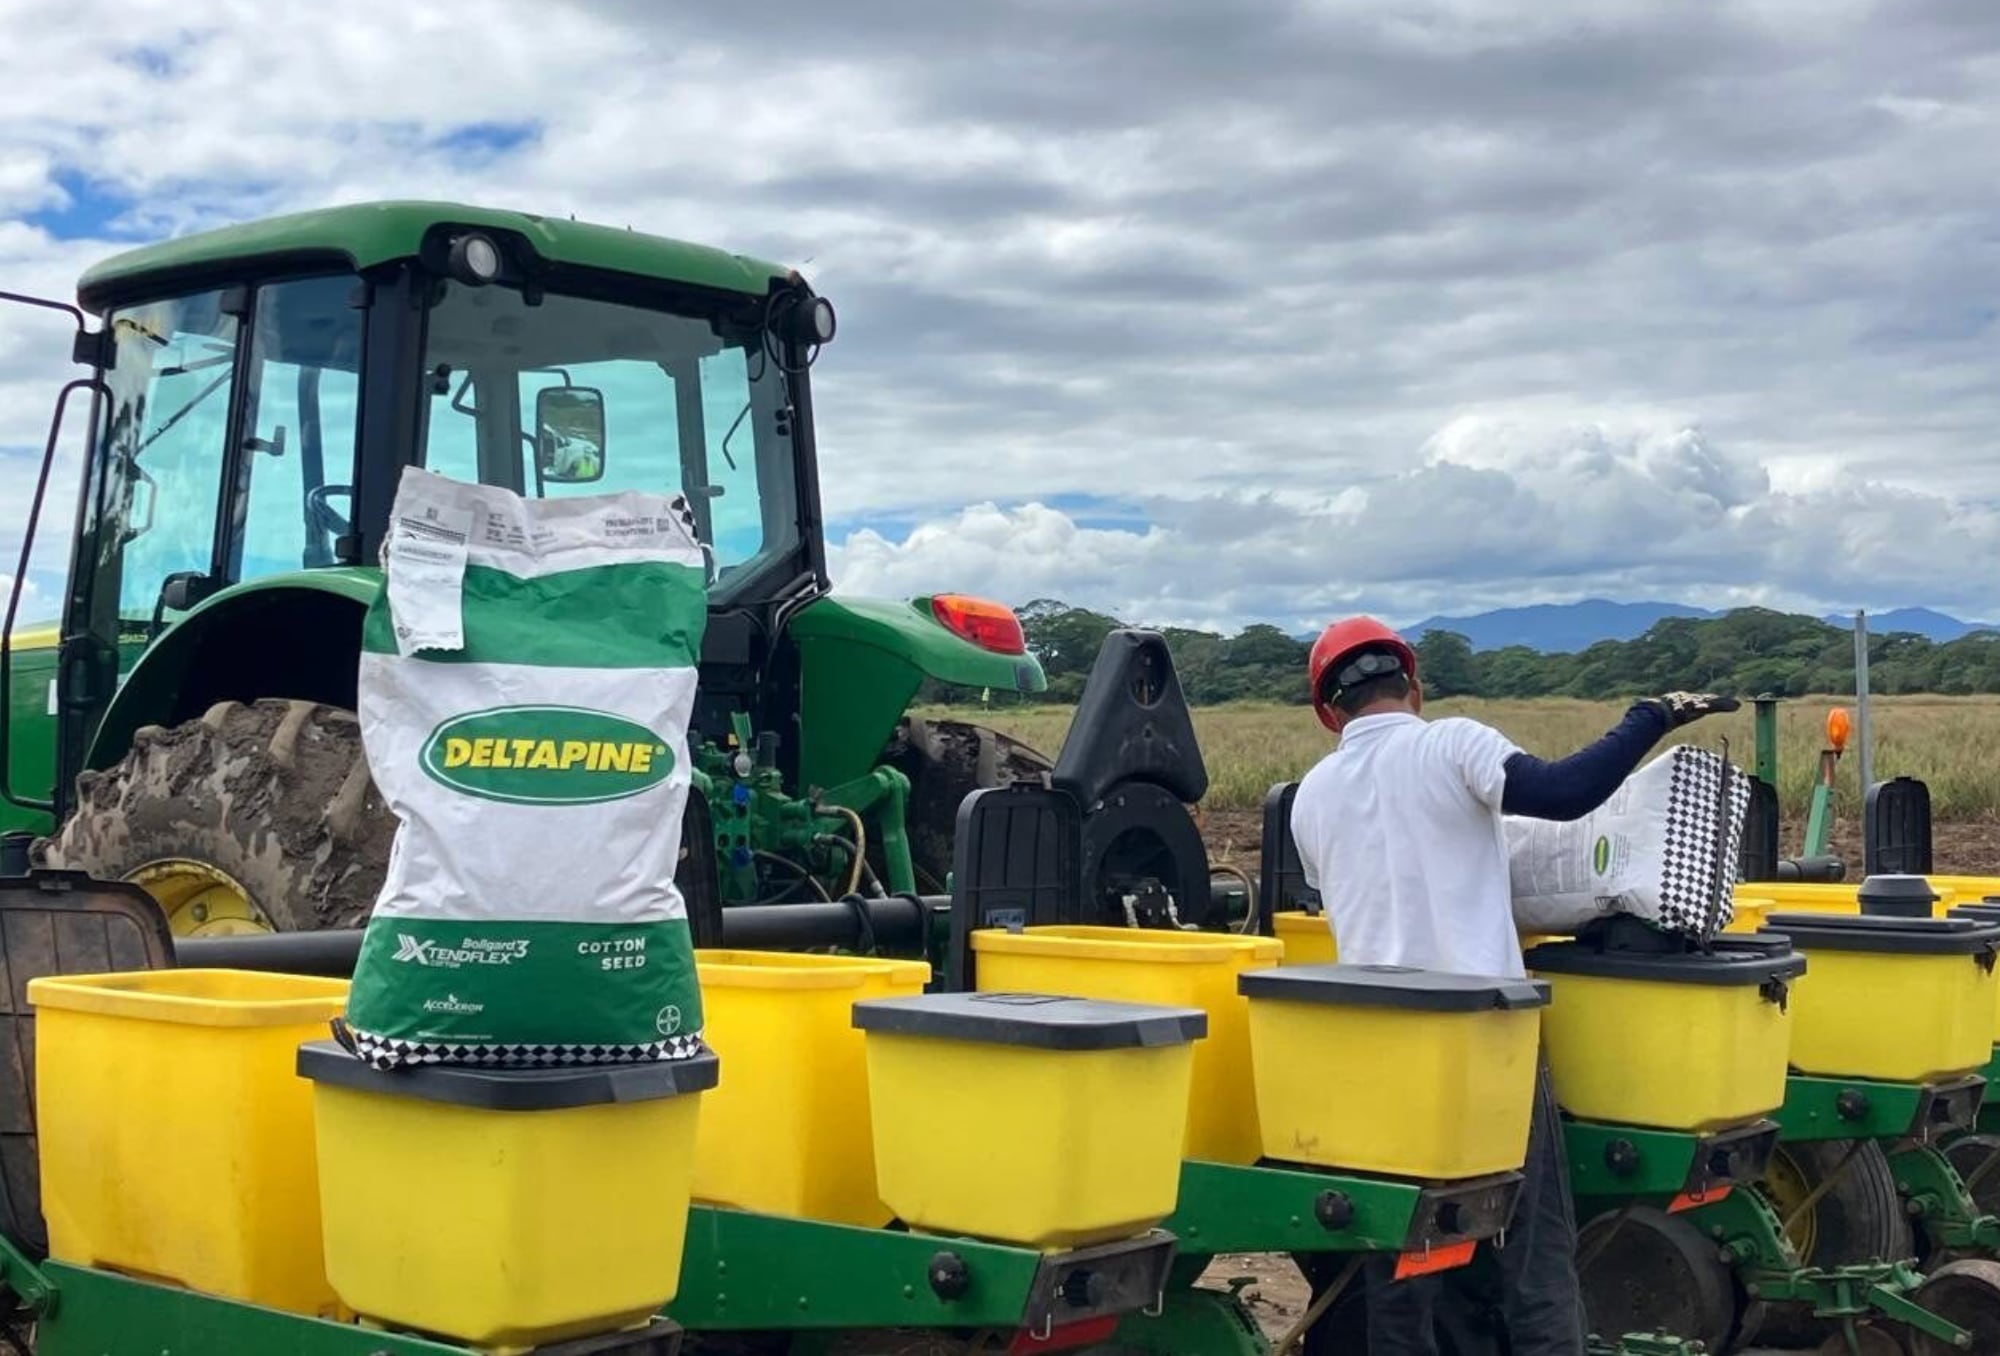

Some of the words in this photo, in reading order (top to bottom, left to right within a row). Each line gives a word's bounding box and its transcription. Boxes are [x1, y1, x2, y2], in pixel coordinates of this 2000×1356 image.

[444, 738, 653, 773] DELTAPINE
[392, 934, 512, 965] XTENDFLEX
[462, 937, 515, 951] Bollgard
[578, 936, 646, 954] COTTON
[601, 954, 646, 970] SEED
